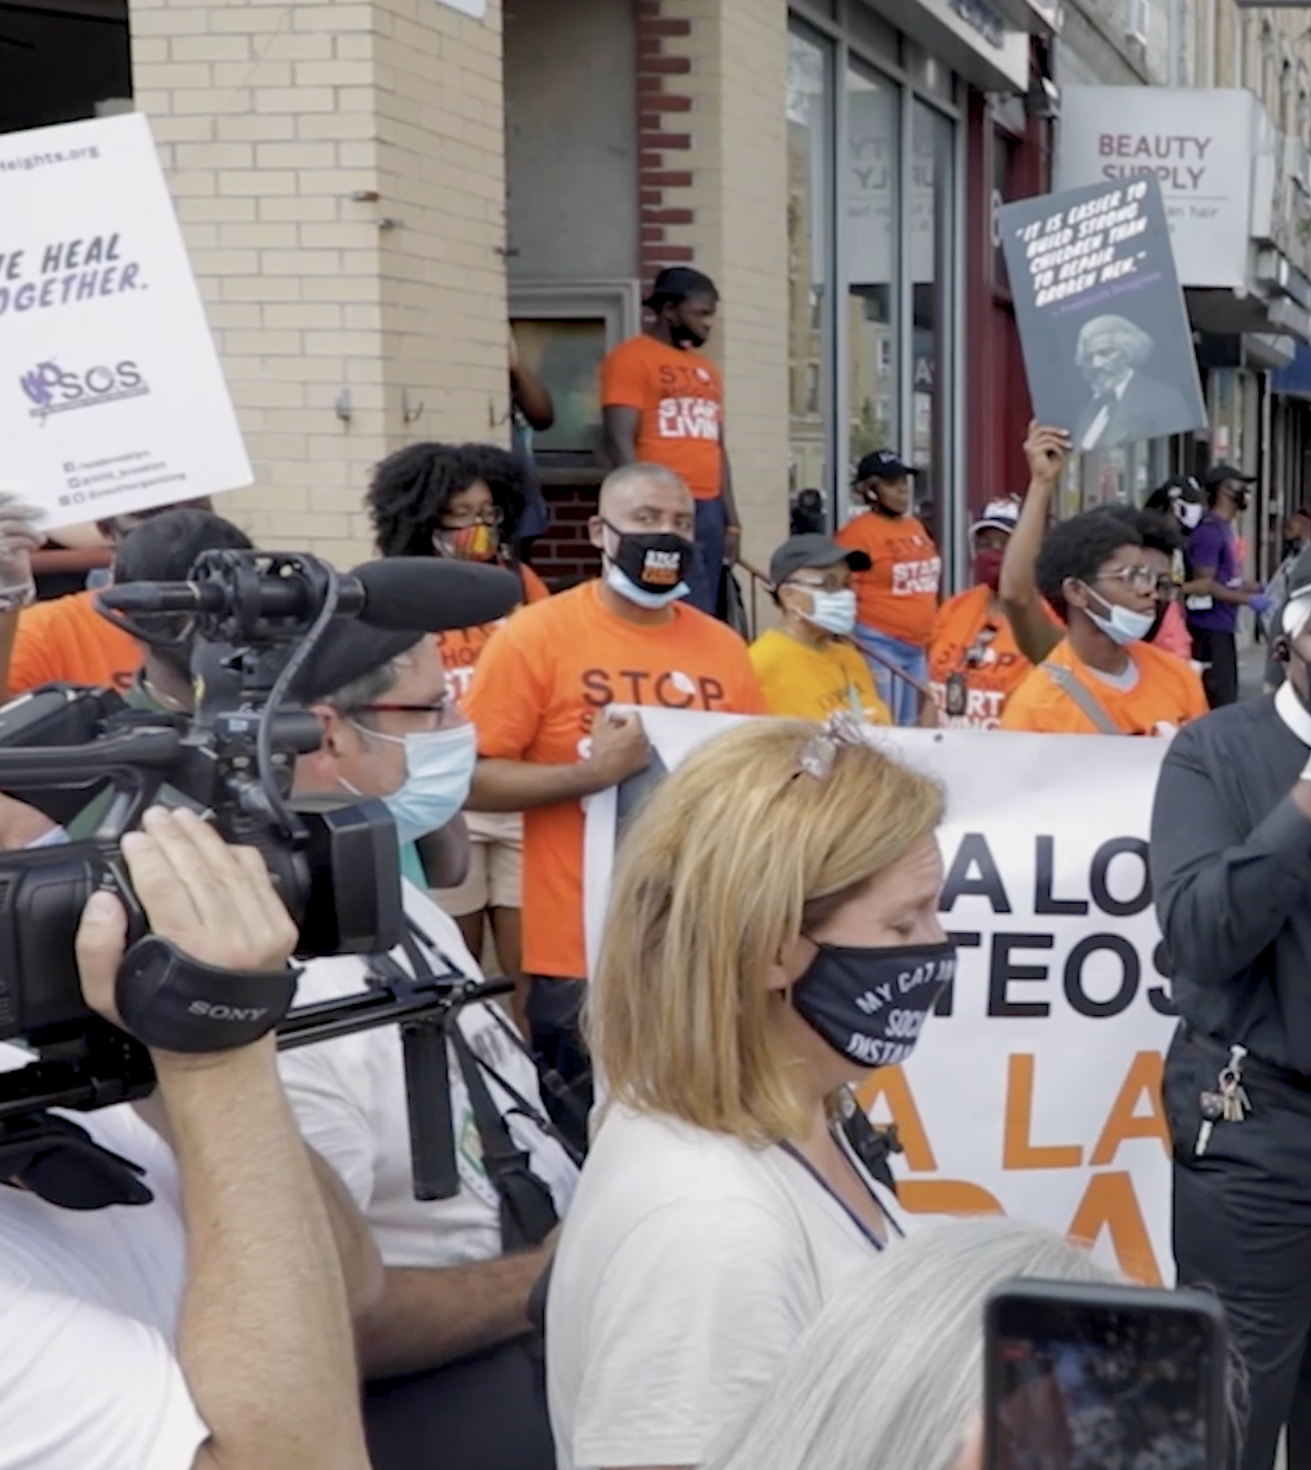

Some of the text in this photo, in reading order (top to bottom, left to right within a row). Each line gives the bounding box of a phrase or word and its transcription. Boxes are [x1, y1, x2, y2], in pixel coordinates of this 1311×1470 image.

[1098, 134, 1211, 160] BEAUTY
[1126, 181, 1147, 201] TO
[1077, 202, 1139, 239] STRONG
[1189, 203, 1219, 219] hair
[41, 233, 121, 274] HEAL
[1030, 216, 1147, 274] CHILDREN THAN
[1034, 269, 1054, 291] TO
[581, 668, 724, 711] STOP
[937, 831, 1013, 915] A
[855, 982, 892, 1016] MY
[897, 961, 935, 994] CAT
[187, 999, 268, 1024] SONY
[1002, 1050, 1175, 1171] LA
